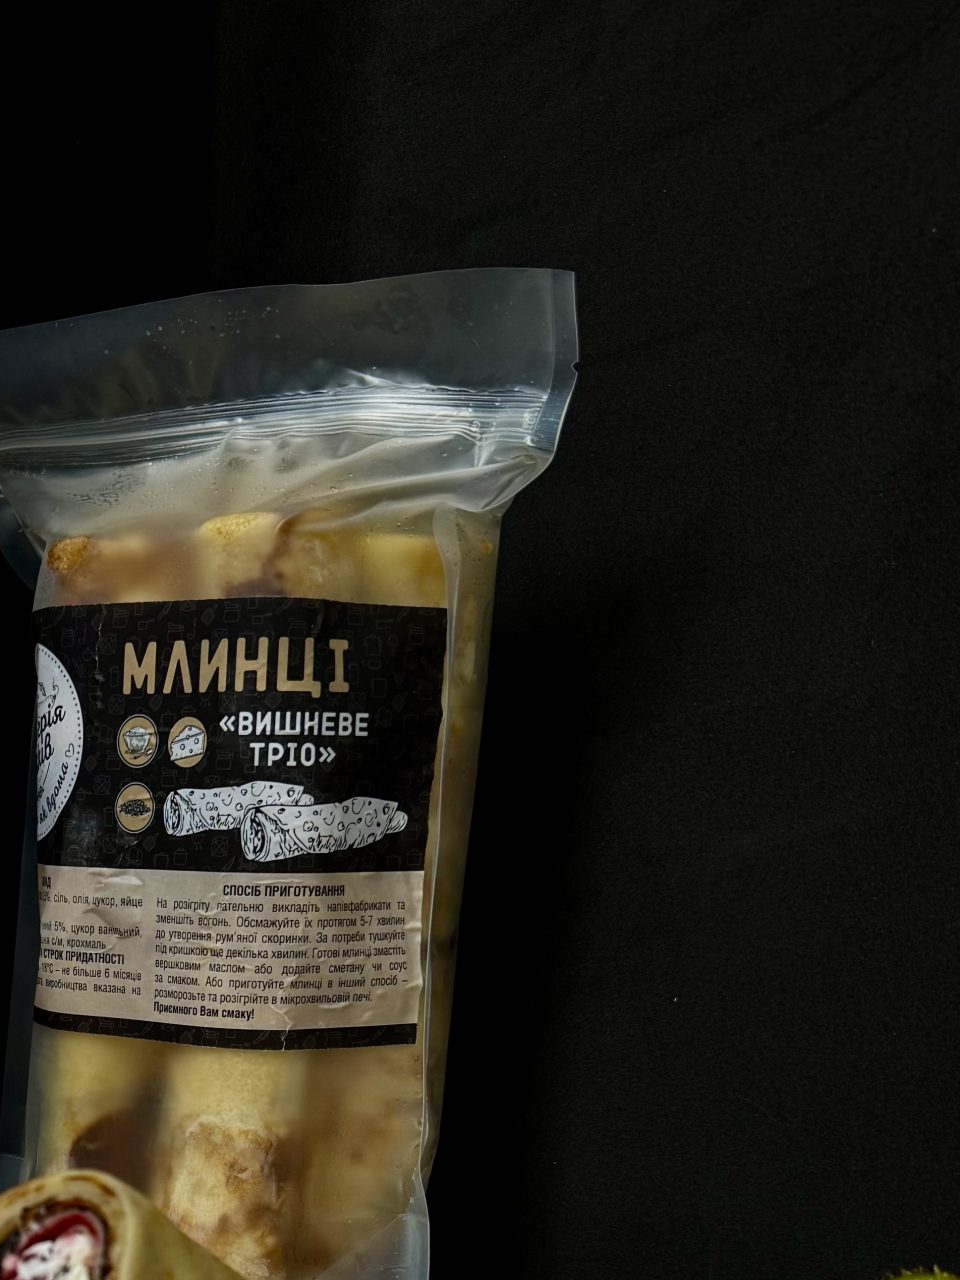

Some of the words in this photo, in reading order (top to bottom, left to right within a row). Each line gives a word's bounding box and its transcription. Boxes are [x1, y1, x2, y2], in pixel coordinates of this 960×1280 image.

[123, 636, 349, 698] МЛИНЦІ
[219, 711, 369, 736] «ВИШНЕВЕ
[249, 742, 336, 767] ТРІО»
[223, 884, 261, 896] СПОСІБ
[264, 884, 345, 897] ПРИГОТУВАННЯ
[120, 896, 143, 908] яйце
[157, 898, 167, 908] На
[173, 899, 210, 912] розігріту
[217, 901, 264, 912] пательню
[272, 901, 320, 914] викладіть
[327, 900, 391, 914] напівфабрикати
[397, 901, 406, 910] та
[71, 924, 95, 936] цукор
[156, 914, 194, 925] зменшіть
[198, 916, 231, 927] вогонь.
[236, 916, 300, 929] Обсмажуйте
[304, 917, 313, 928] їх
[317, 918, 357, 930] протягом
[360, 916, 373, 926] 5-7
[377, 917, 406, 926] хвилин
[67, 939, 107, 950] крохмаль
[155, 929, 166, 940] до
[169, 930, 212, 943] утворення
[261, 934, 312, 946] скоринки.
[316, 932, 328, 943] За
[332, 930, 365, 943] потреби
[369, 930, 406, 943] тушкуйте
[43, 948, 64, 960] СТРОК
[65, 950, 125, 965] ПРИДАТНОСТІ
[155, 944, 167, 955] під
[169, 945, 208, 957] кришкою
[211, 948, 224, 958] ще
[226, 948, 269, 959] декілька
[271, 949, 309, 960] хвилин.
[312, 947, 340, 959] Готові
[342, 946, 372, 958] млинці
[373, 945, 406, 957] змастіть
[62, 967, 71, 975] не
[73, 966, 101, 978] більше
[104, 968, 110, 978] 6
[113, 969, 142, 981] місяців
[155, 959, 201, 971] вершковим
[209, 963, 246, 973] маслом
[254, 963, 273, 974] або
[281, 963, 320, 976] додайте
[329, 964, 366, 975] сметану
[372, 963, 382, 972] чи
[389, 961, 408, 973] соус
[93, 983, 126, 994] вказана
[132, 987, 141, 996] на
[154, 974, 163, 983] за
[167, 975, 200, 986] смаком.
[205, 976, 223, 988] Або
[228, 978, 285, 992] приготуйте
[289, 978, 322, 990] млинці
[327, 980, 333, 989] в
[338, 977, 366, 988] інший
[370, 975, 398, 986] спосіб
[154, 989, 206, 1001] розморозьте
[208, 993, 217, 1002] та
[220, 993, 269, 1005] розігрійте
[280, 992, 350, 1006] мікрохвильовій
[352, 991, 373, 1002] печі.
[153, 1002, 198, 1016] Приємного
[200, 1006, 219, 1017] Вам
[221, 1009, 255, 1021] смаку!
